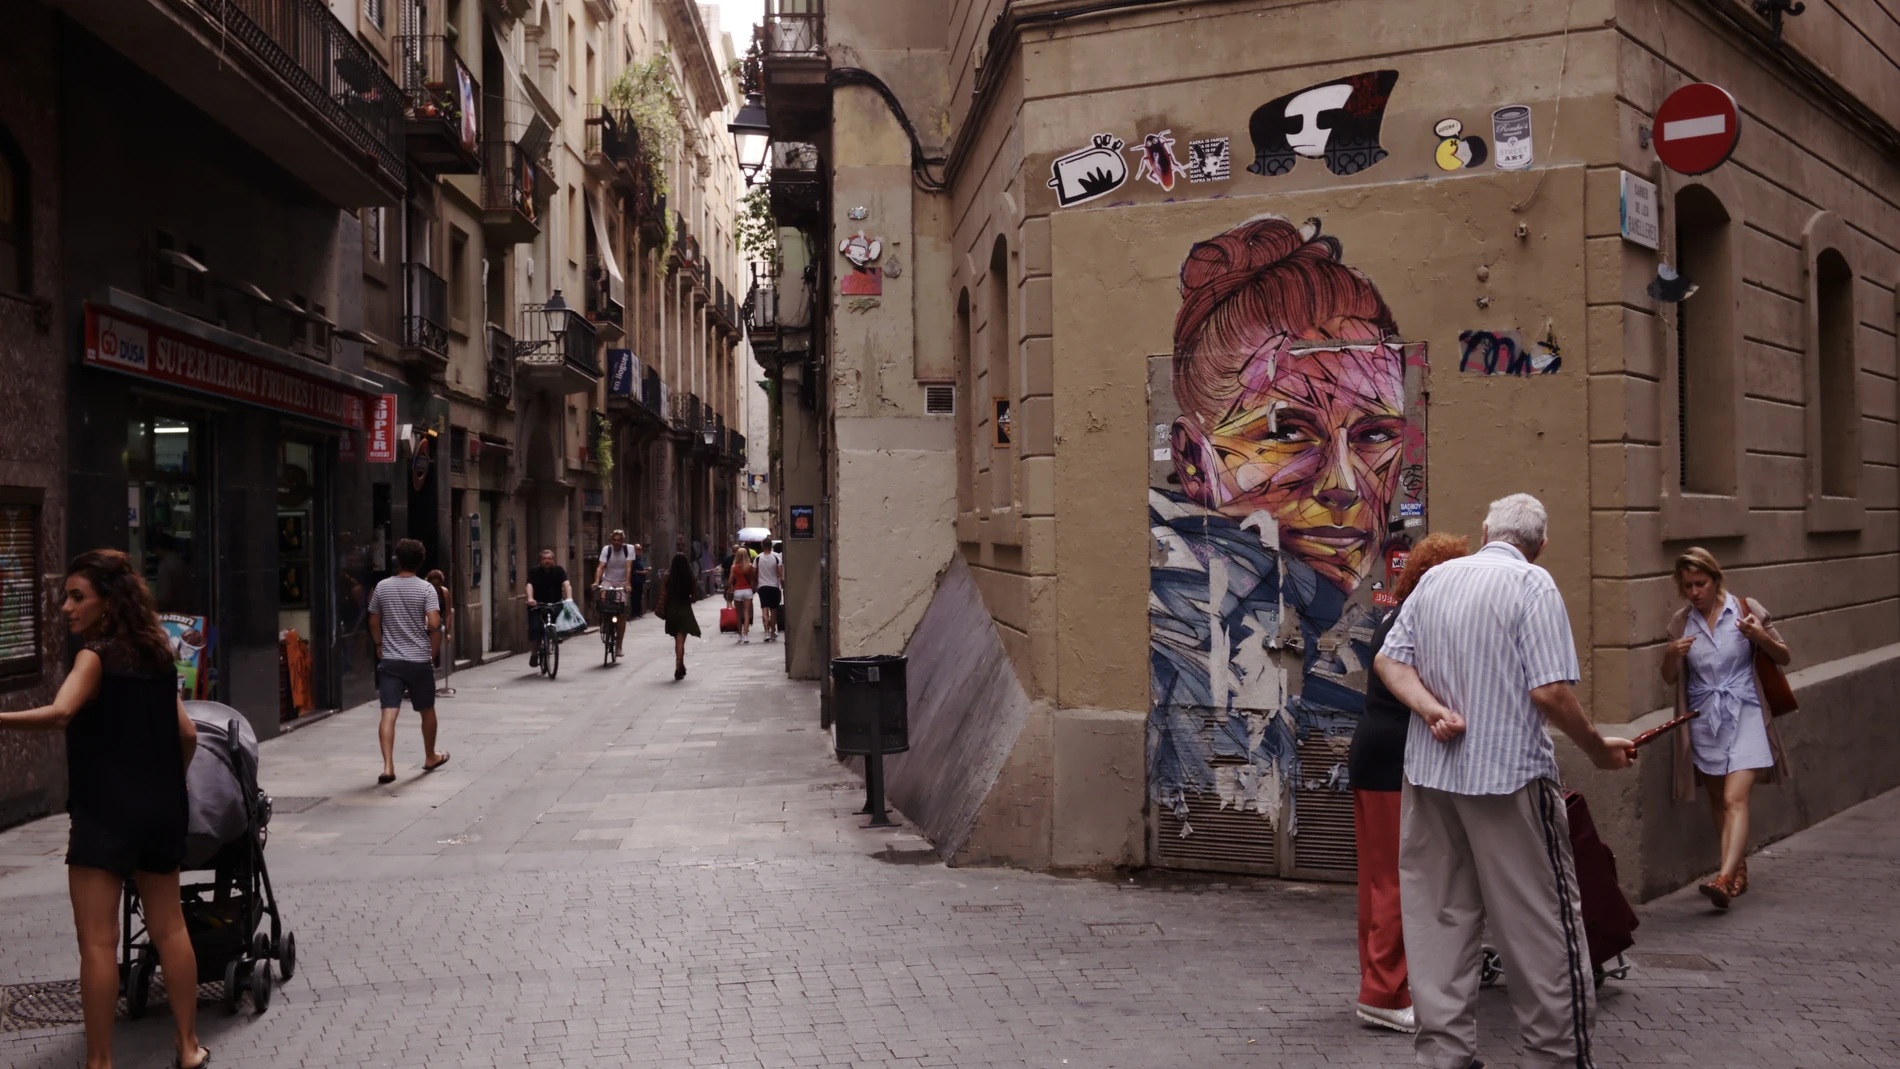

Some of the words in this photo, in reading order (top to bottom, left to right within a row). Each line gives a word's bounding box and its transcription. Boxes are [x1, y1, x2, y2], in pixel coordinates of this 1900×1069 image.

[1499, 146, 1528, 156] STREET
[1634, 184, 1648, 200] CARRER
[1635, 201, 1641, 214] DE
[1628, 216, 1657, 241] RAMELLERES
[155, 336, 258, 395] SUPERMERCAT
[259, 367, 308, 408] FRUITES
[615, 353, 629, 380] lloguer
[613, 380, 621, 391] en
[373, 399, 388, 451] SUPER
